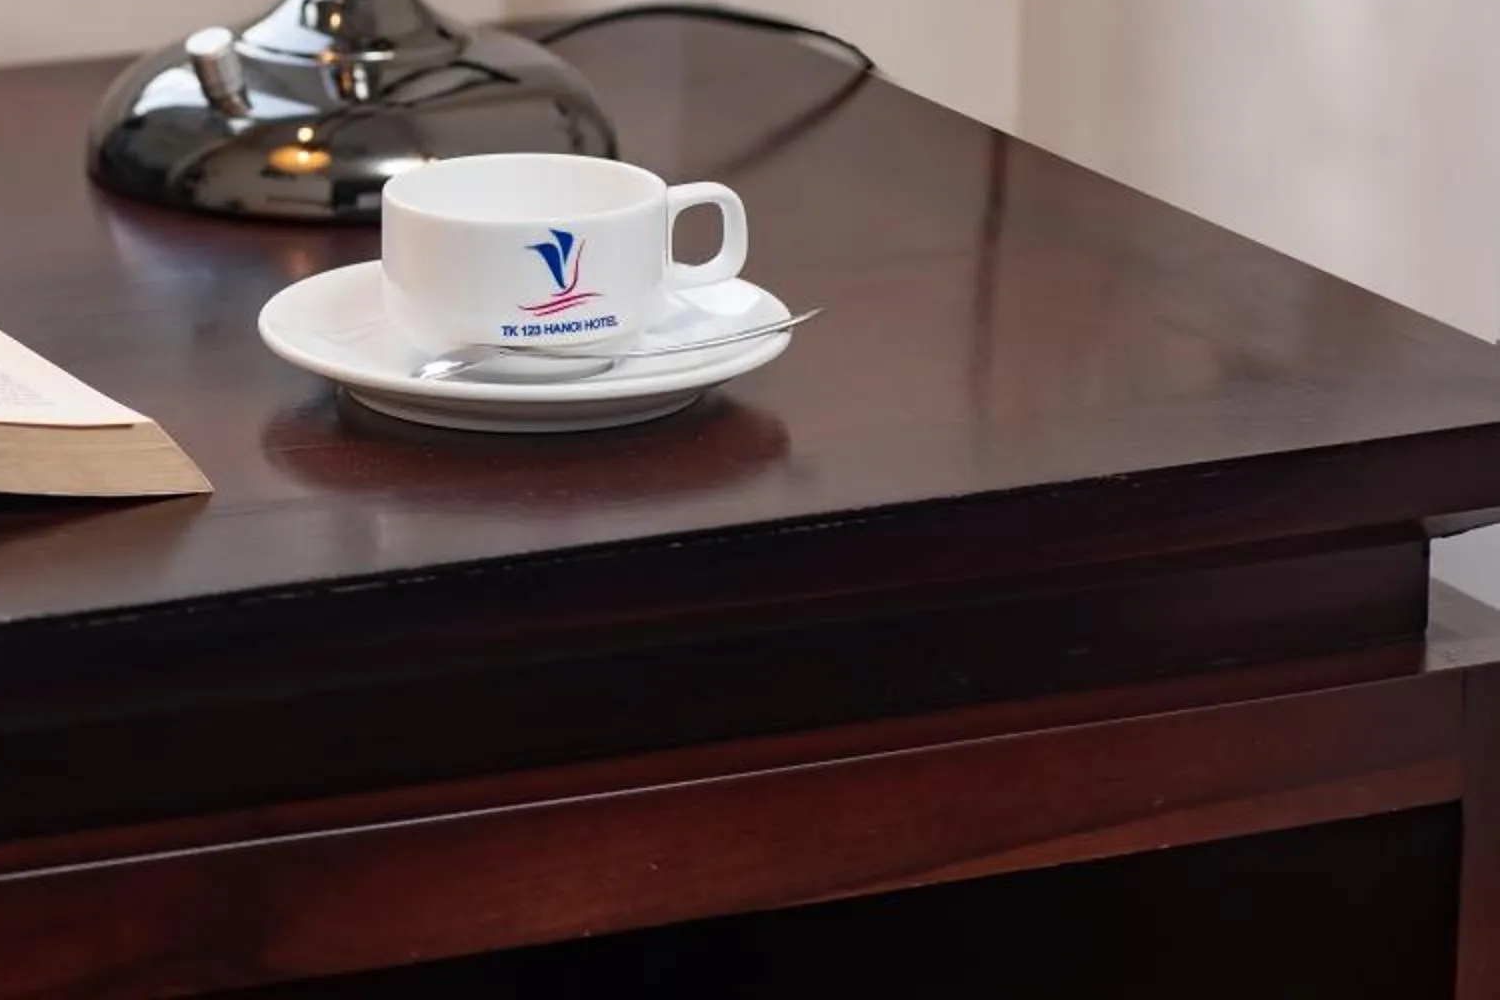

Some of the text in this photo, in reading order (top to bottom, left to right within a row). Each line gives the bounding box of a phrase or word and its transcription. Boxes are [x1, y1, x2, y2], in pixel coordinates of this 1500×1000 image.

[500, 315, 619, 337] TK 123 HANOI HOTEL
